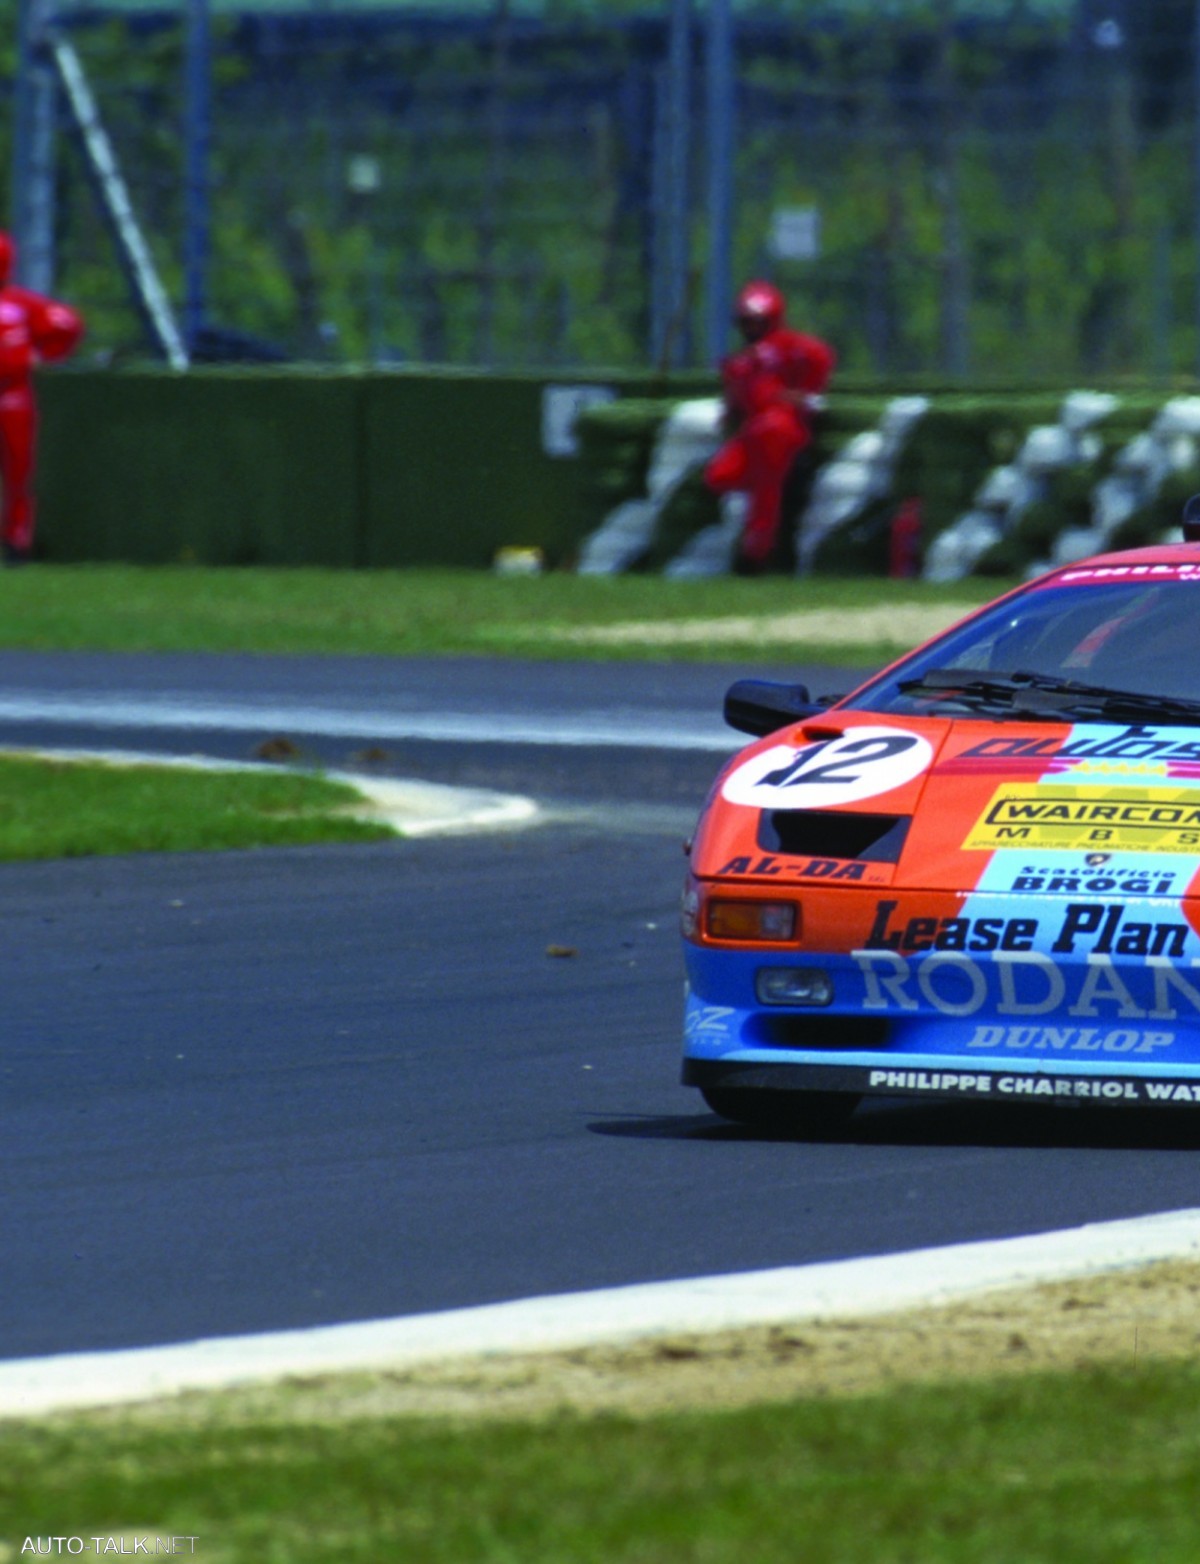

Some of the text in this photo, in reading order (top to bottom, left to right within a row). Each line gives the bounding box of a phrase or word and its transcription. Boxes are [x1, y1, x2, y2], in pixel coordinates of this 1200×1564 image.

[752, 735, 919, 789] 12
[995, 827, 1031, 838] M
[1089, 829, 1113, 841] B
[1177, 832, 1200, 844] S
[716, 856, 869, 881] AL-DA
[1010, 876, 1174, 894] BROGI
[864, 900, 1189, 957] Lease Plan
[967, 1026, 1175, 1053] DUNLOP
[869, 1070, 992, 1093] PHILIPPE
[998, 1076, 1139, 1099] CHARRIOL
